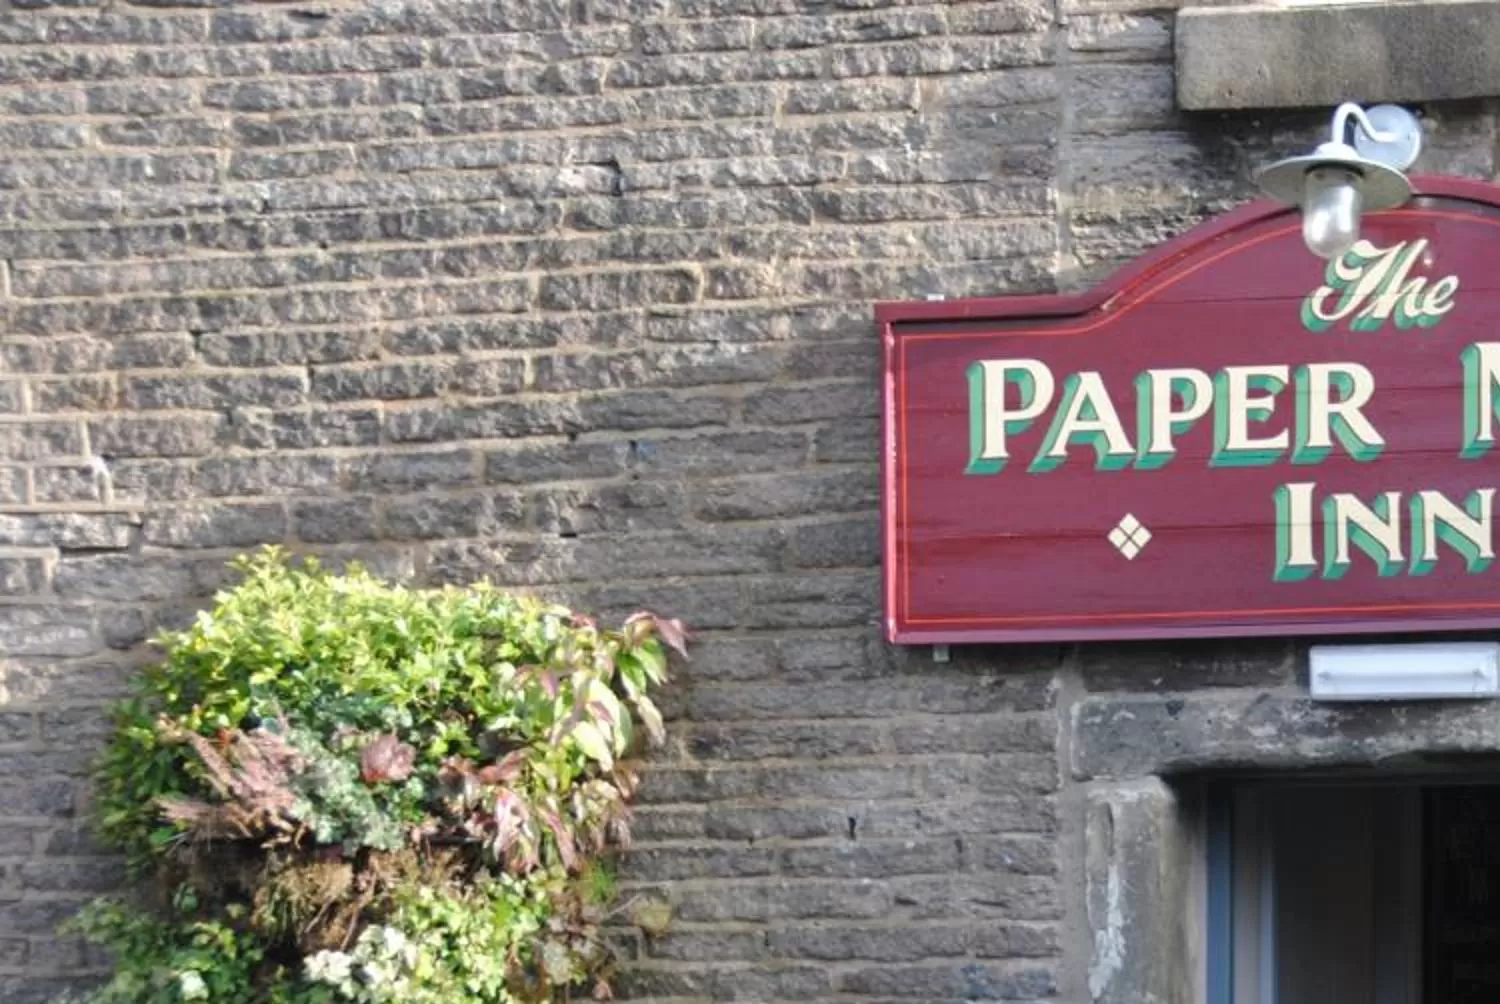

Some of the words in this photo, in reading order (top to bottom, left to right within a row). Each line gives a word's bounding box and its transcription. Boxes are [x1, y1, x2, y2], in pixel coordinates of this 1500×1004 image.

[1303, 239, 1459, 330] The
[965, 357, 1386, 475] PAPER
[1272, 482, 1497, 582] INN
